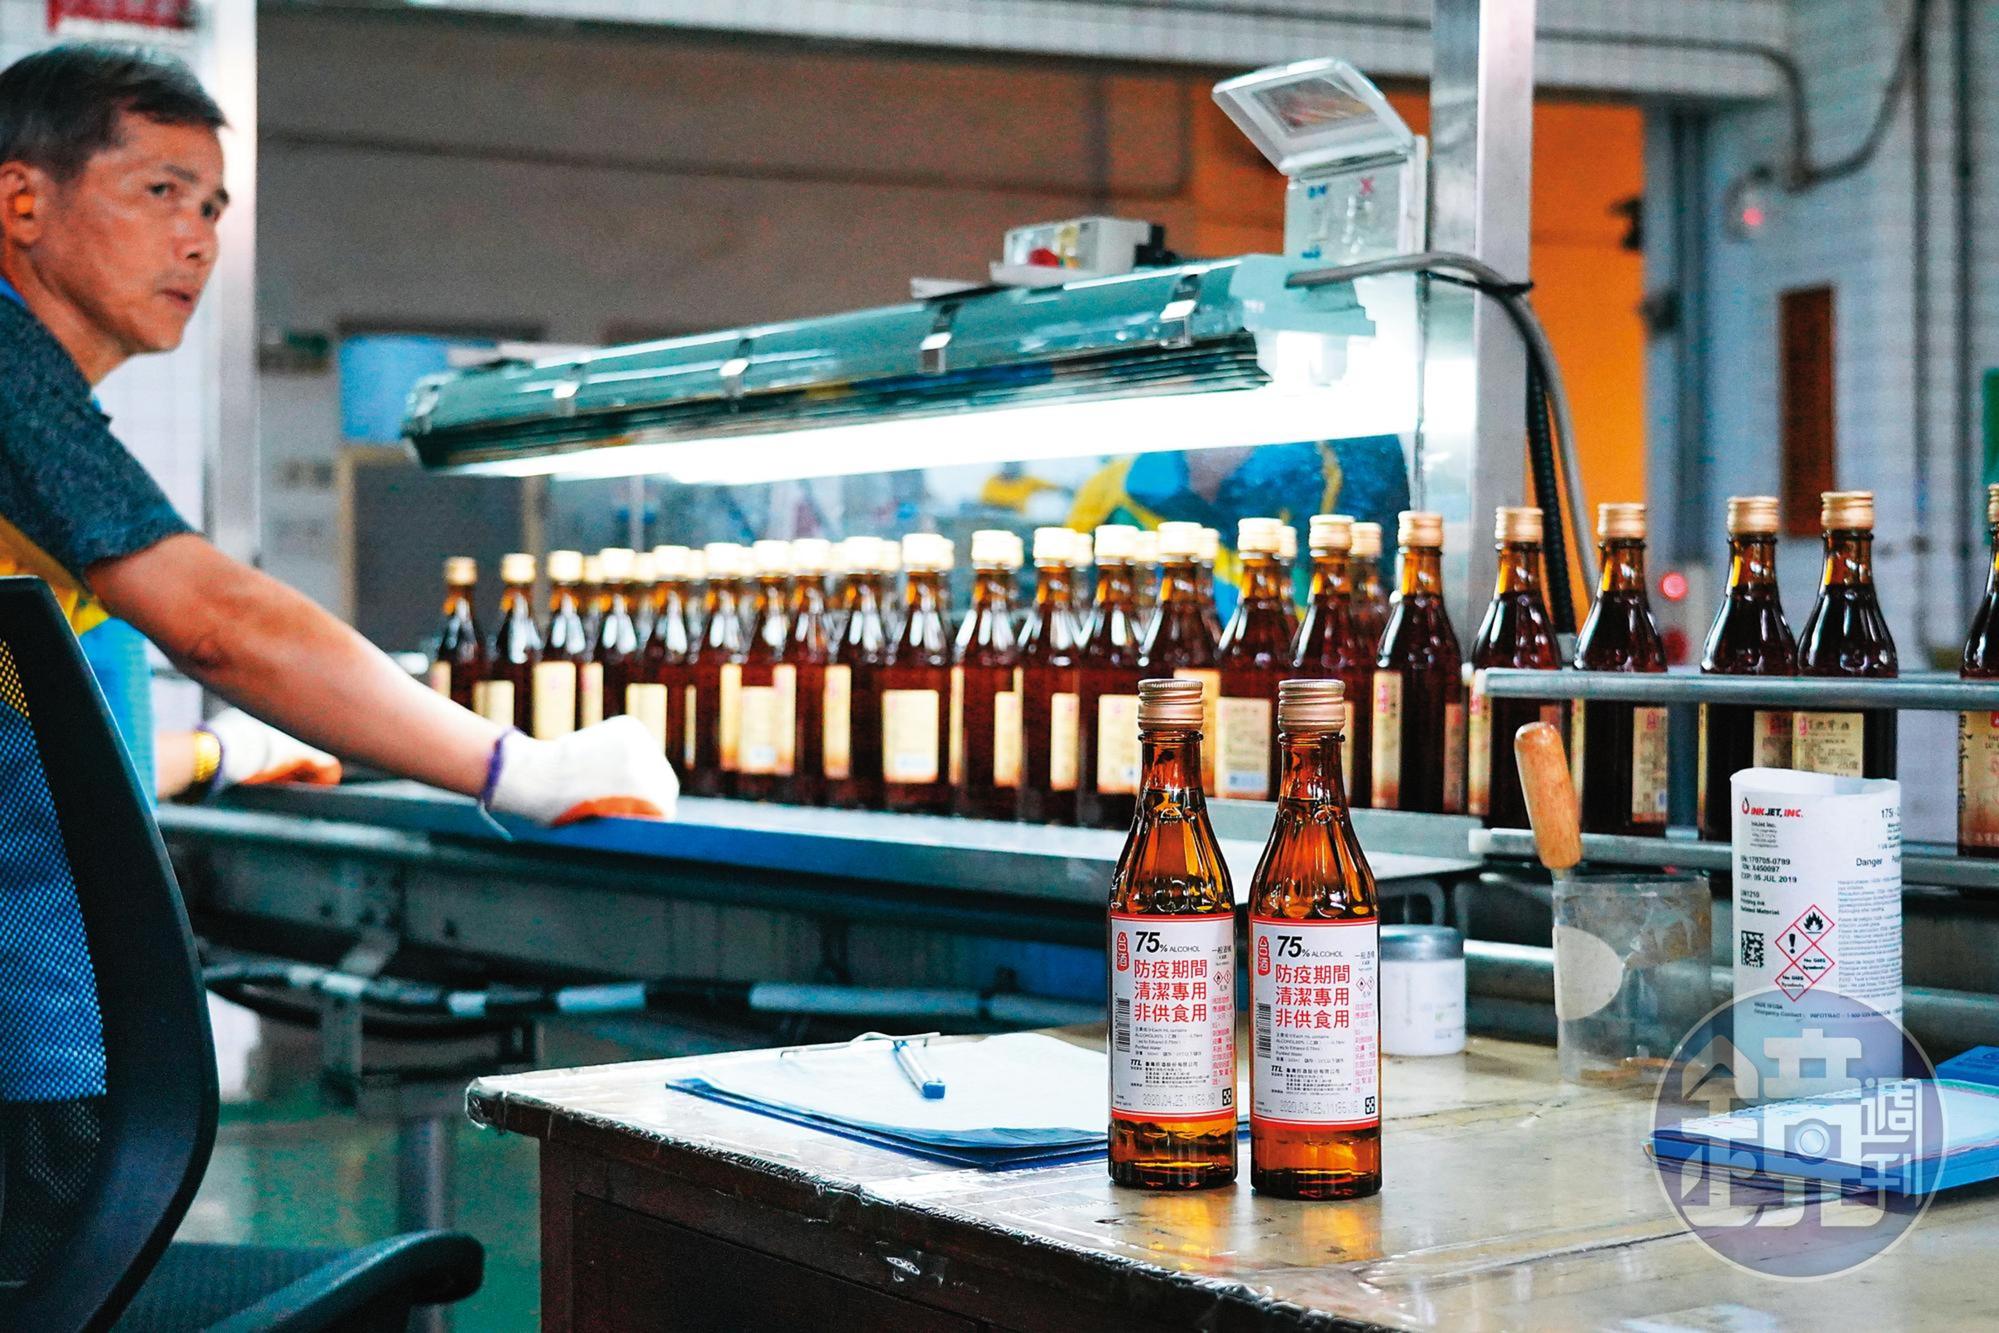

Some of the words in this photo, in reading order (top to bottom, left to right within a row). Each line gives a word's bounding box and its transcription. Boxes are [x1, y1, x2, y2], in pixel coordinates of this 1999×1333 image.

[1783, 808, 1803, 818] INC.
[1856, 857, 1882, 867] Danger
[1169, 945, 1201, 953] ALCOHOL
[1311, 950, 1343, 958] ALCOHOL
[1134, 959, 1208, 979] 防疫期間
[1275, 964, 1350, 985] 防疫期間
[1134, 981, 1207, 1001] 清潔專用
[1275, 986, 1350, 1007] 清潔專用
[1134, 1003, 1207, 1023] 非供食用
[1275, 1008, 1350, 1030] 非供食用
[1130, 1058, 1142, 1066] TTL
